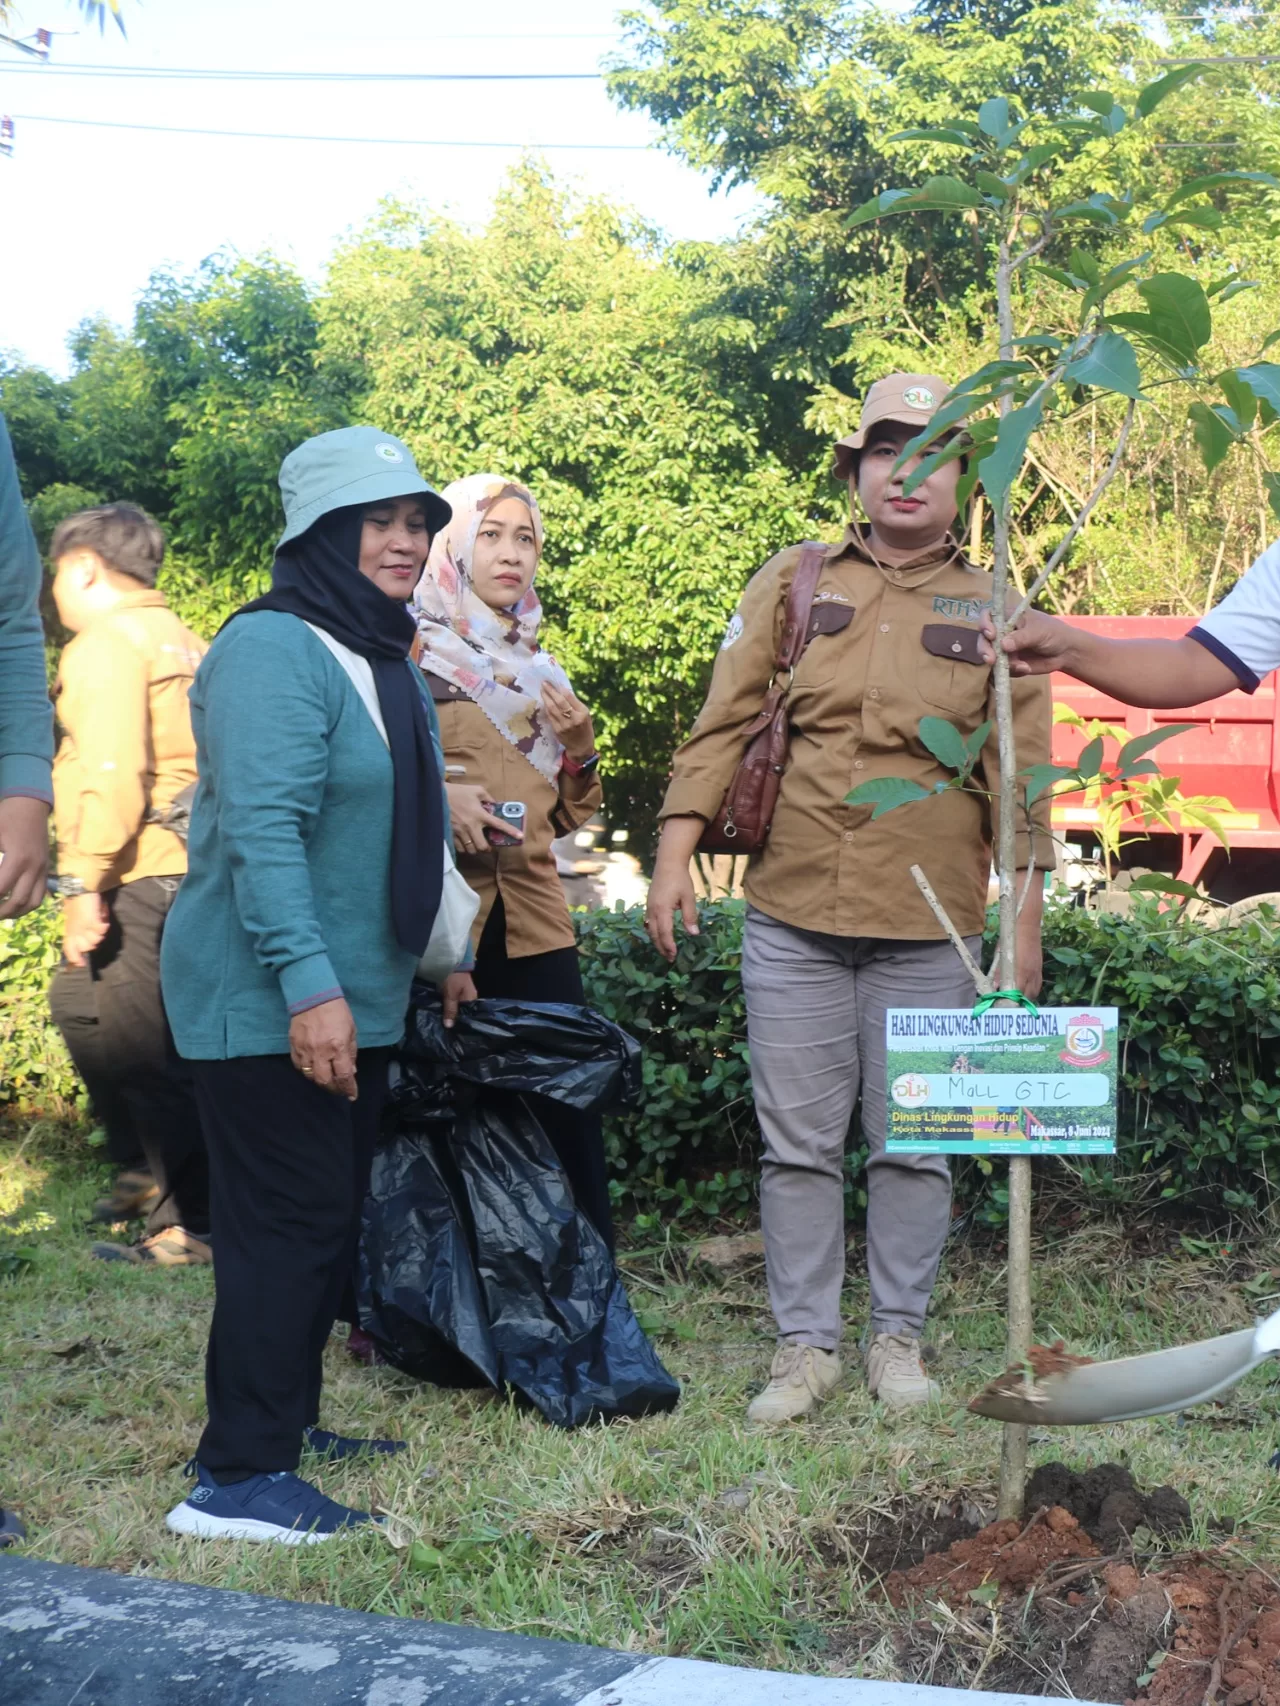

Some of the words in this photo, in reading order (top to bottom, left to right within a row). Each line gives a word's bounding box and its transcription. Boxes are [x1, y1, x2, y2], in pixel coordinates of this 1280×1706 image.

[891, 1015, 916, 1036] HARI
[918, 1014, 982, 1036] LINGKUNGAN
[984, 1014, 1014, 1036] HIDUP
[1016, 1014, 1059, 1036] SEDUNIA
[1015, 1081, 1071, 1102] GTC
[892, 1112, 922, 1122] Dinas
[924, 1111, 985, 1123] Lingkungan
[988, 1112, 1019, 1123] Hidup
[1030, 1125, 1067, 1139] Makassar,
[1075, 1125, 1092, 1136] Juni
[1093, 1126, 1110, 1137] 2024
